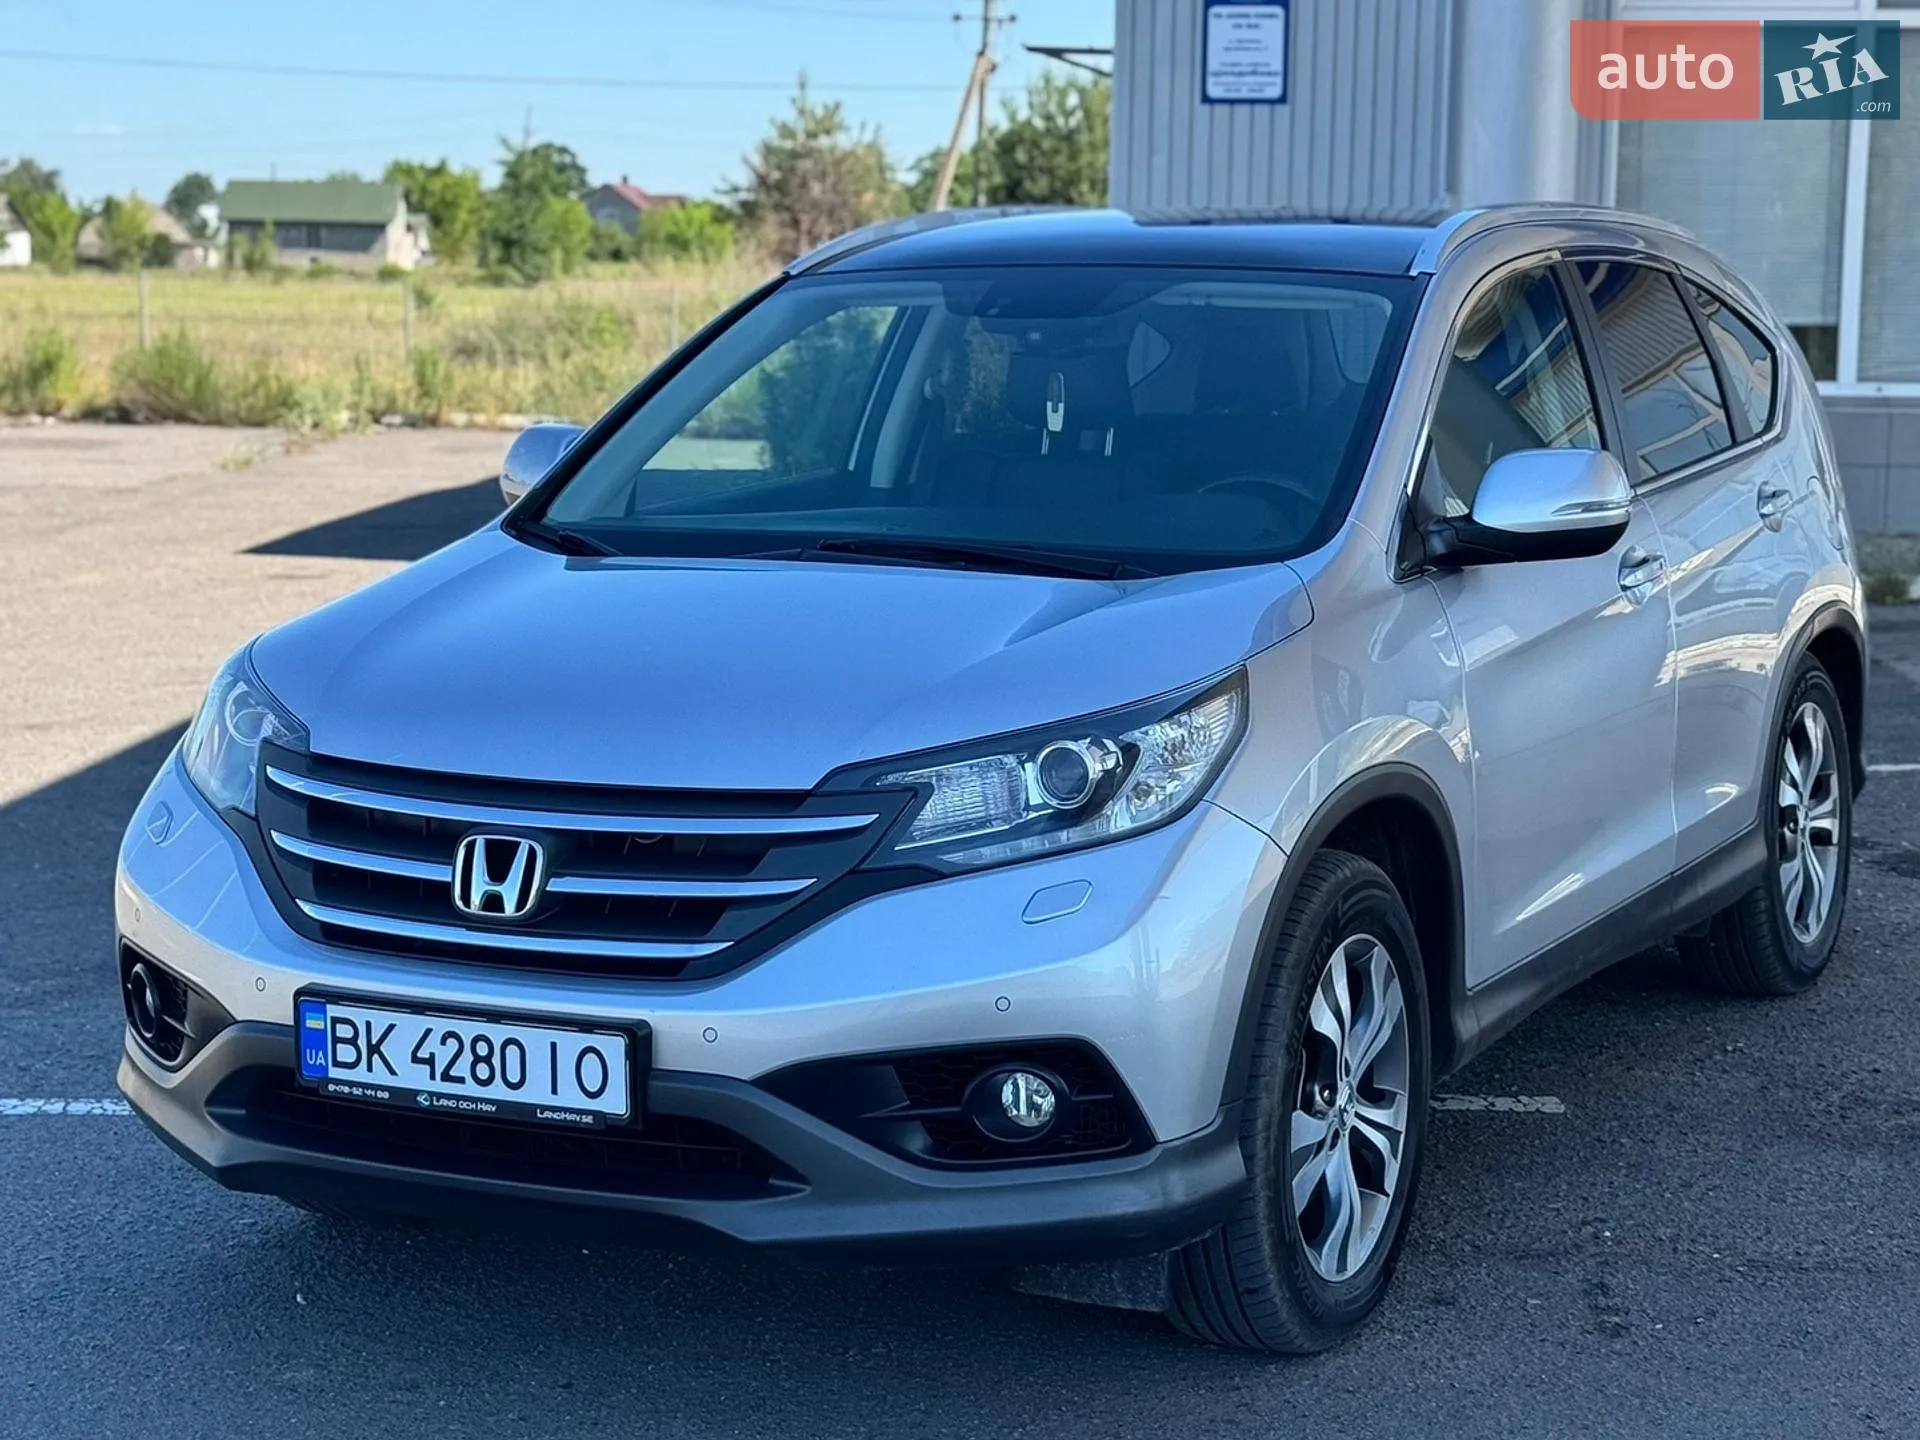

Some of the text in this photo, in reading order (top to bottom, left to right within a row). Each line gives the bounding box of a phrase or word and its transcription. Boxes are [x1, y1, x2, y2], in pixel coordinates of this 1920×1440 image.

[306, 1048, 327, 1067] UA
[330, 1016, 399, 1077] BK
[410, 1027, 527, 1092] 4280
